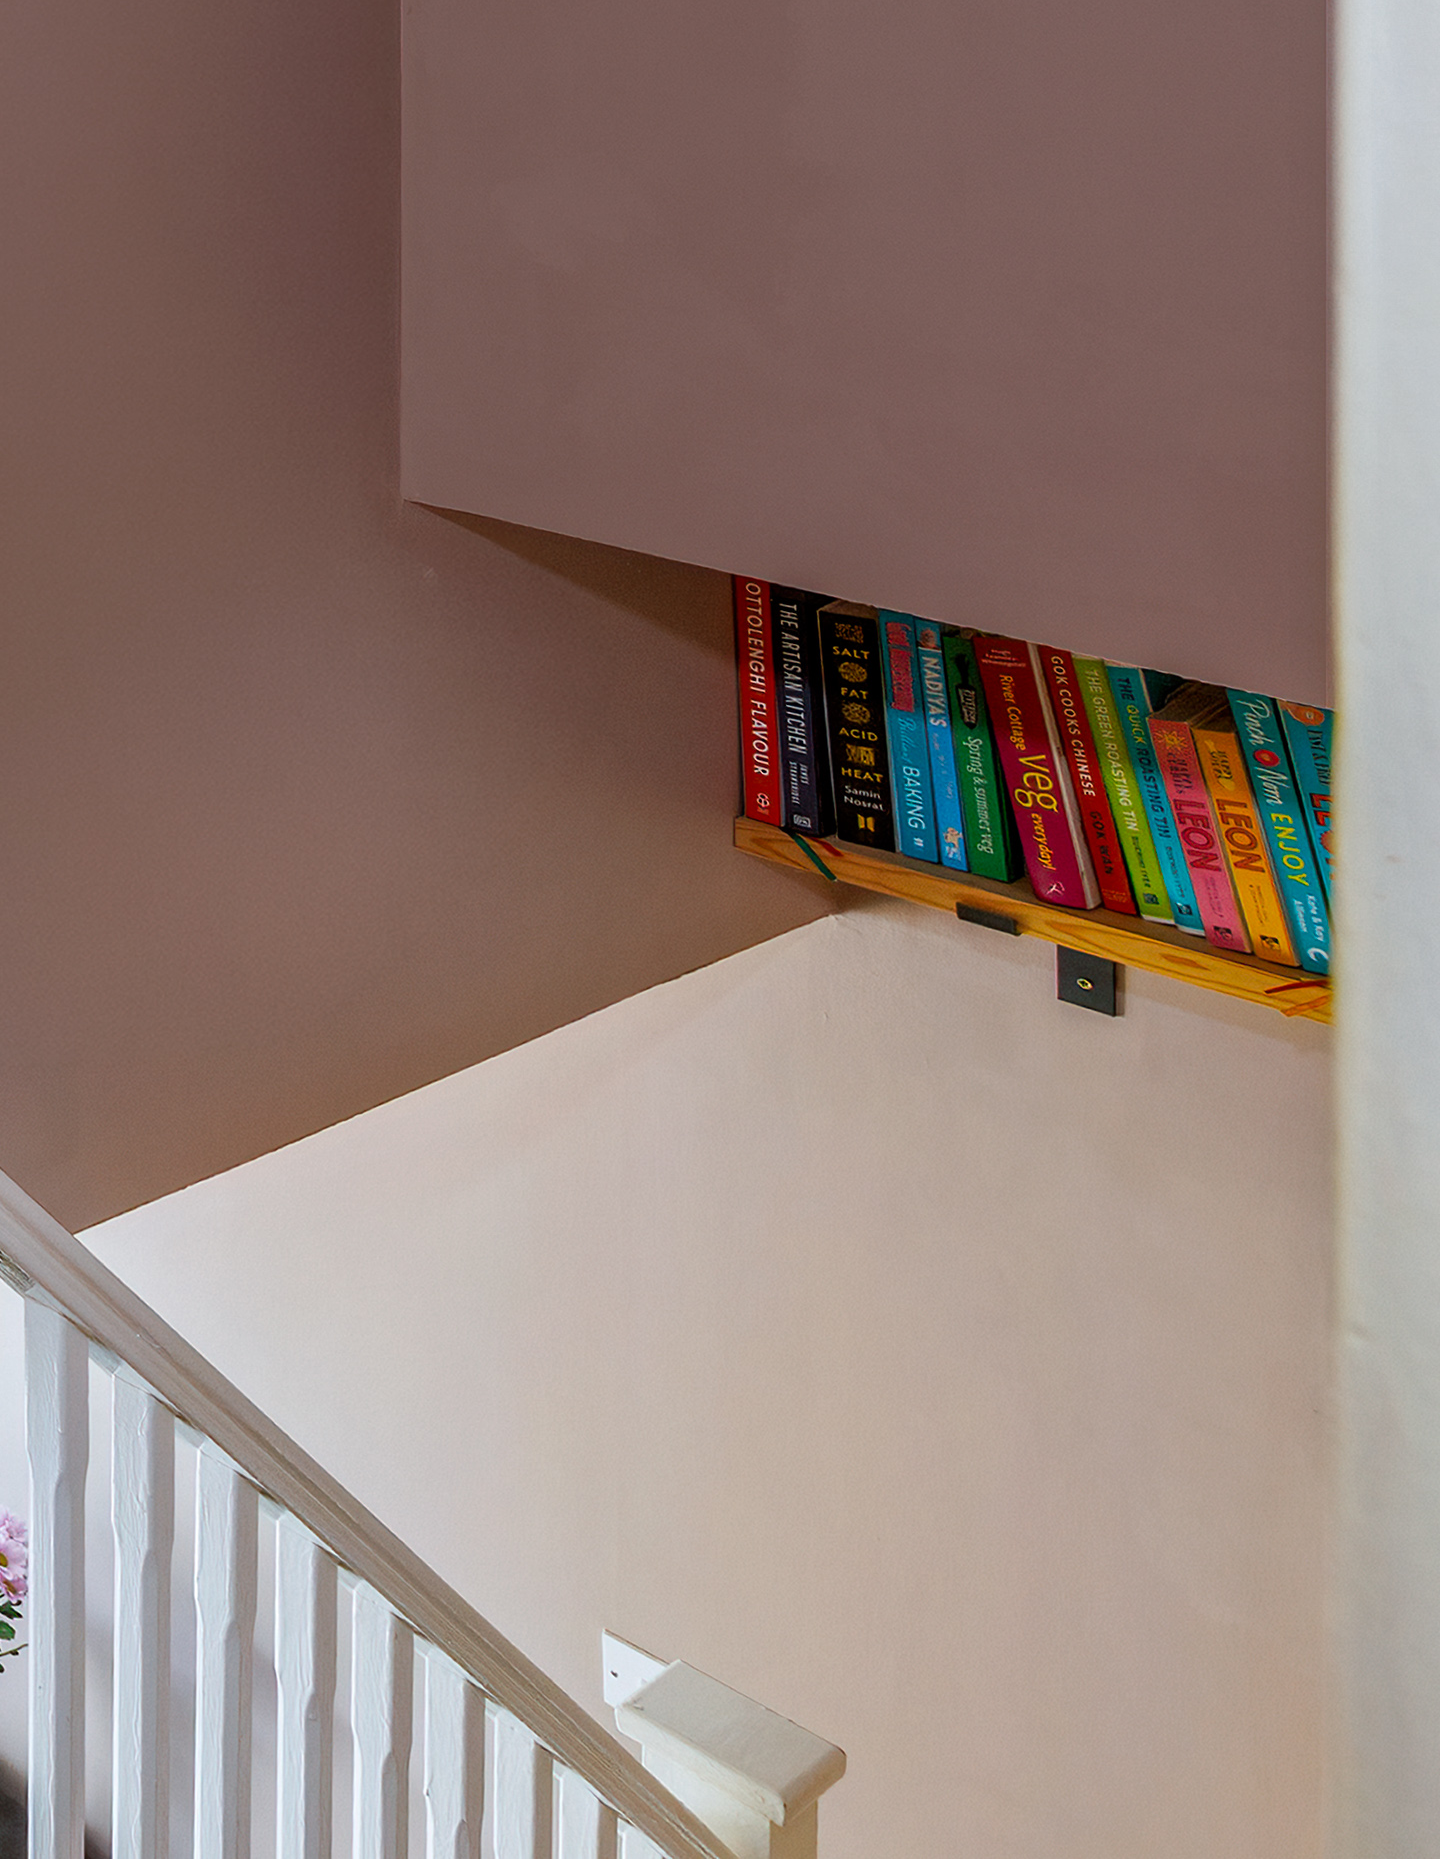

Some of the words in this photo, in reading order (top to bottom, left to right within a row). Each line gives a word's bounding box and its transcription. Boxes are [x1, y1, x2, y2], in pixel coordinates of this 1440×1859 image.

[745, 582, 767, 693] OTTOLENGHI
[779, 603, 799, 629] THE
[781, 631, 803, 691] ARTISAN
[832, 645, 871, 660] SALT
[1050, 654, 1069, 685] GOK
[840, 687, 869, 701] FAT
[921, 655, 948, 728] NADIYA'S
[1058, 688, 1081, 736] COOKS
[750, 699, 770, 776] FLAVOUR
[784, 695, 808, 755] KITCHEN
[838, 727, 879, 742] ACID
[841, 767, 884, 784] HEAT
[1069, 739, 1096, 797] CHINESE
[1116, 676, 1135, 702] THE
[1126, 704, 1146, 745] QUICK
[1136, 747, 1162, 814] ROASTING
[1154, 817, 1172, 839] TIN
[843, 795, 884, 812] Nosrat
[844, 784, 882, 800] Samin
[1173, 798, 1222, 873] LEON
[1215, 797, 1265, 874] LEON
[1269, 812, 1310, 887] ENJOY
